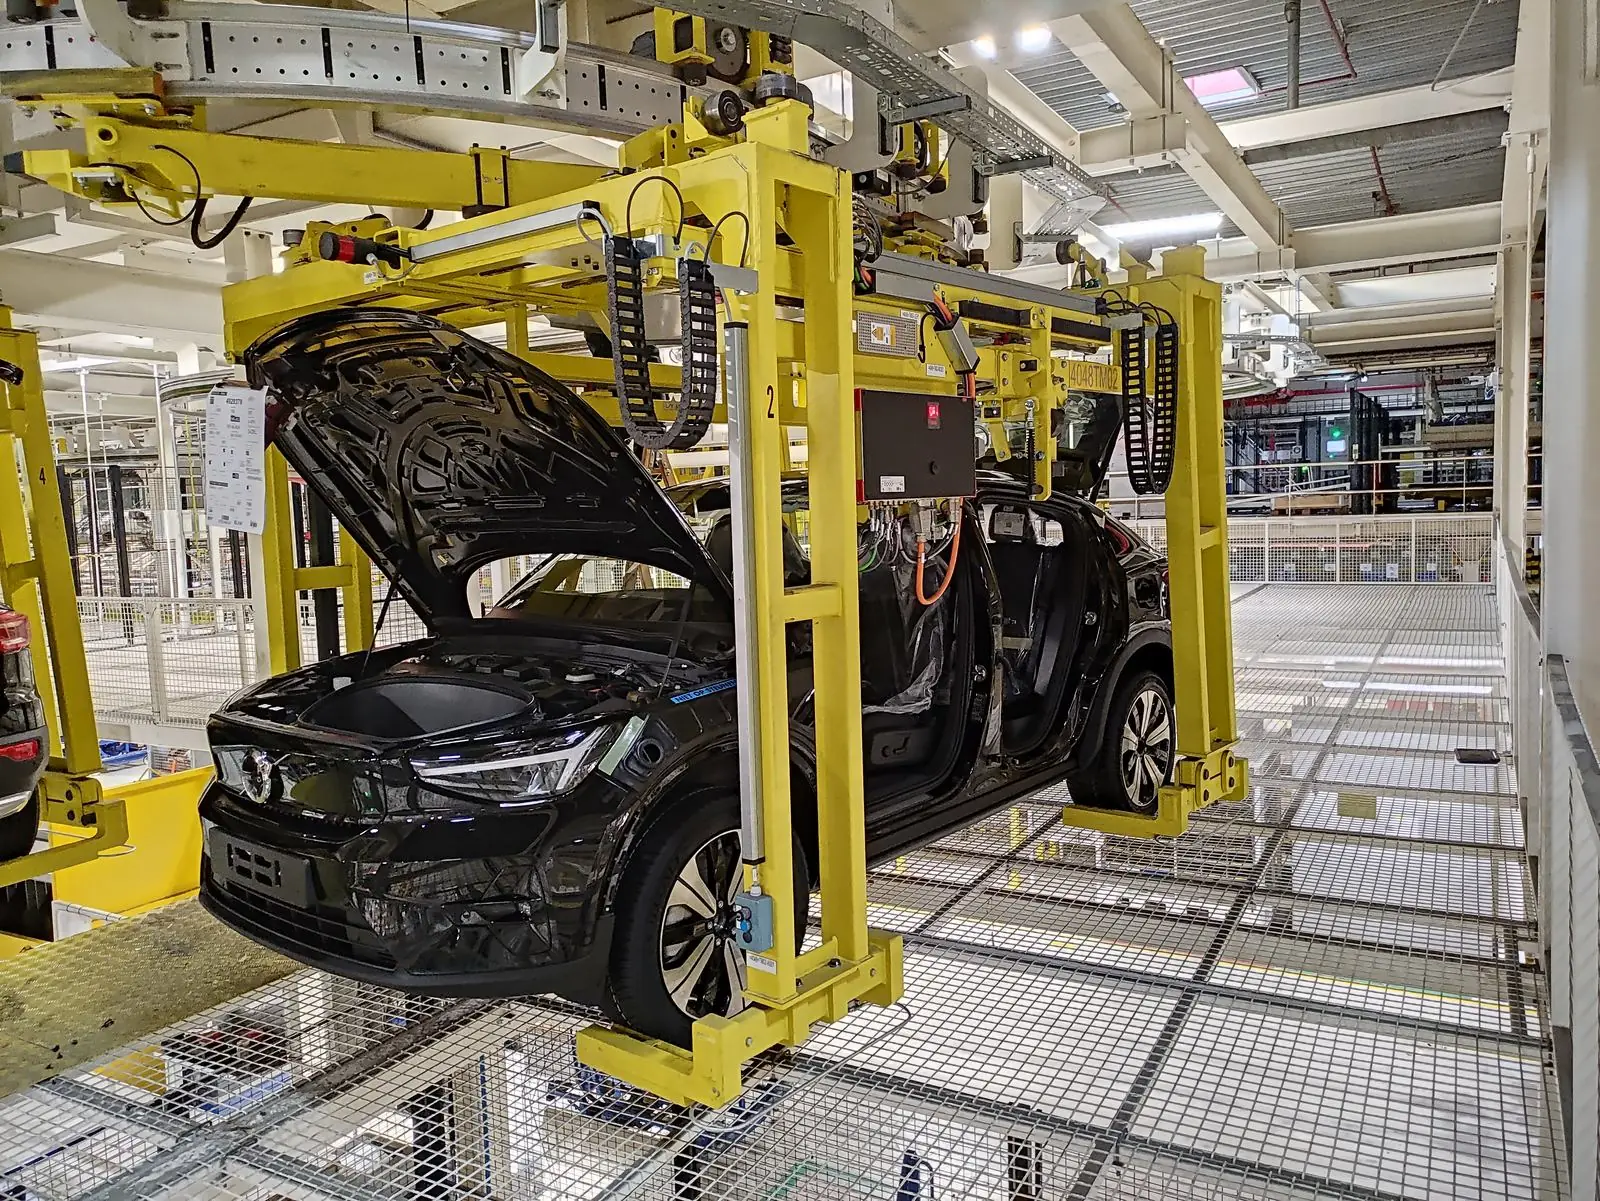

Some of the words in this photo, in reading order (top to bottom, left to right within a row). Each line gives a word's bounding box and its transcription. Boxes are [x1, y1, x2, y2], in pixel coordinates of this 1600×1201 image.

[1070, 362, 1118, 390] 4048TM02
[766, 384, 775, 419] 2
[39, 467, 46, 485] 4
